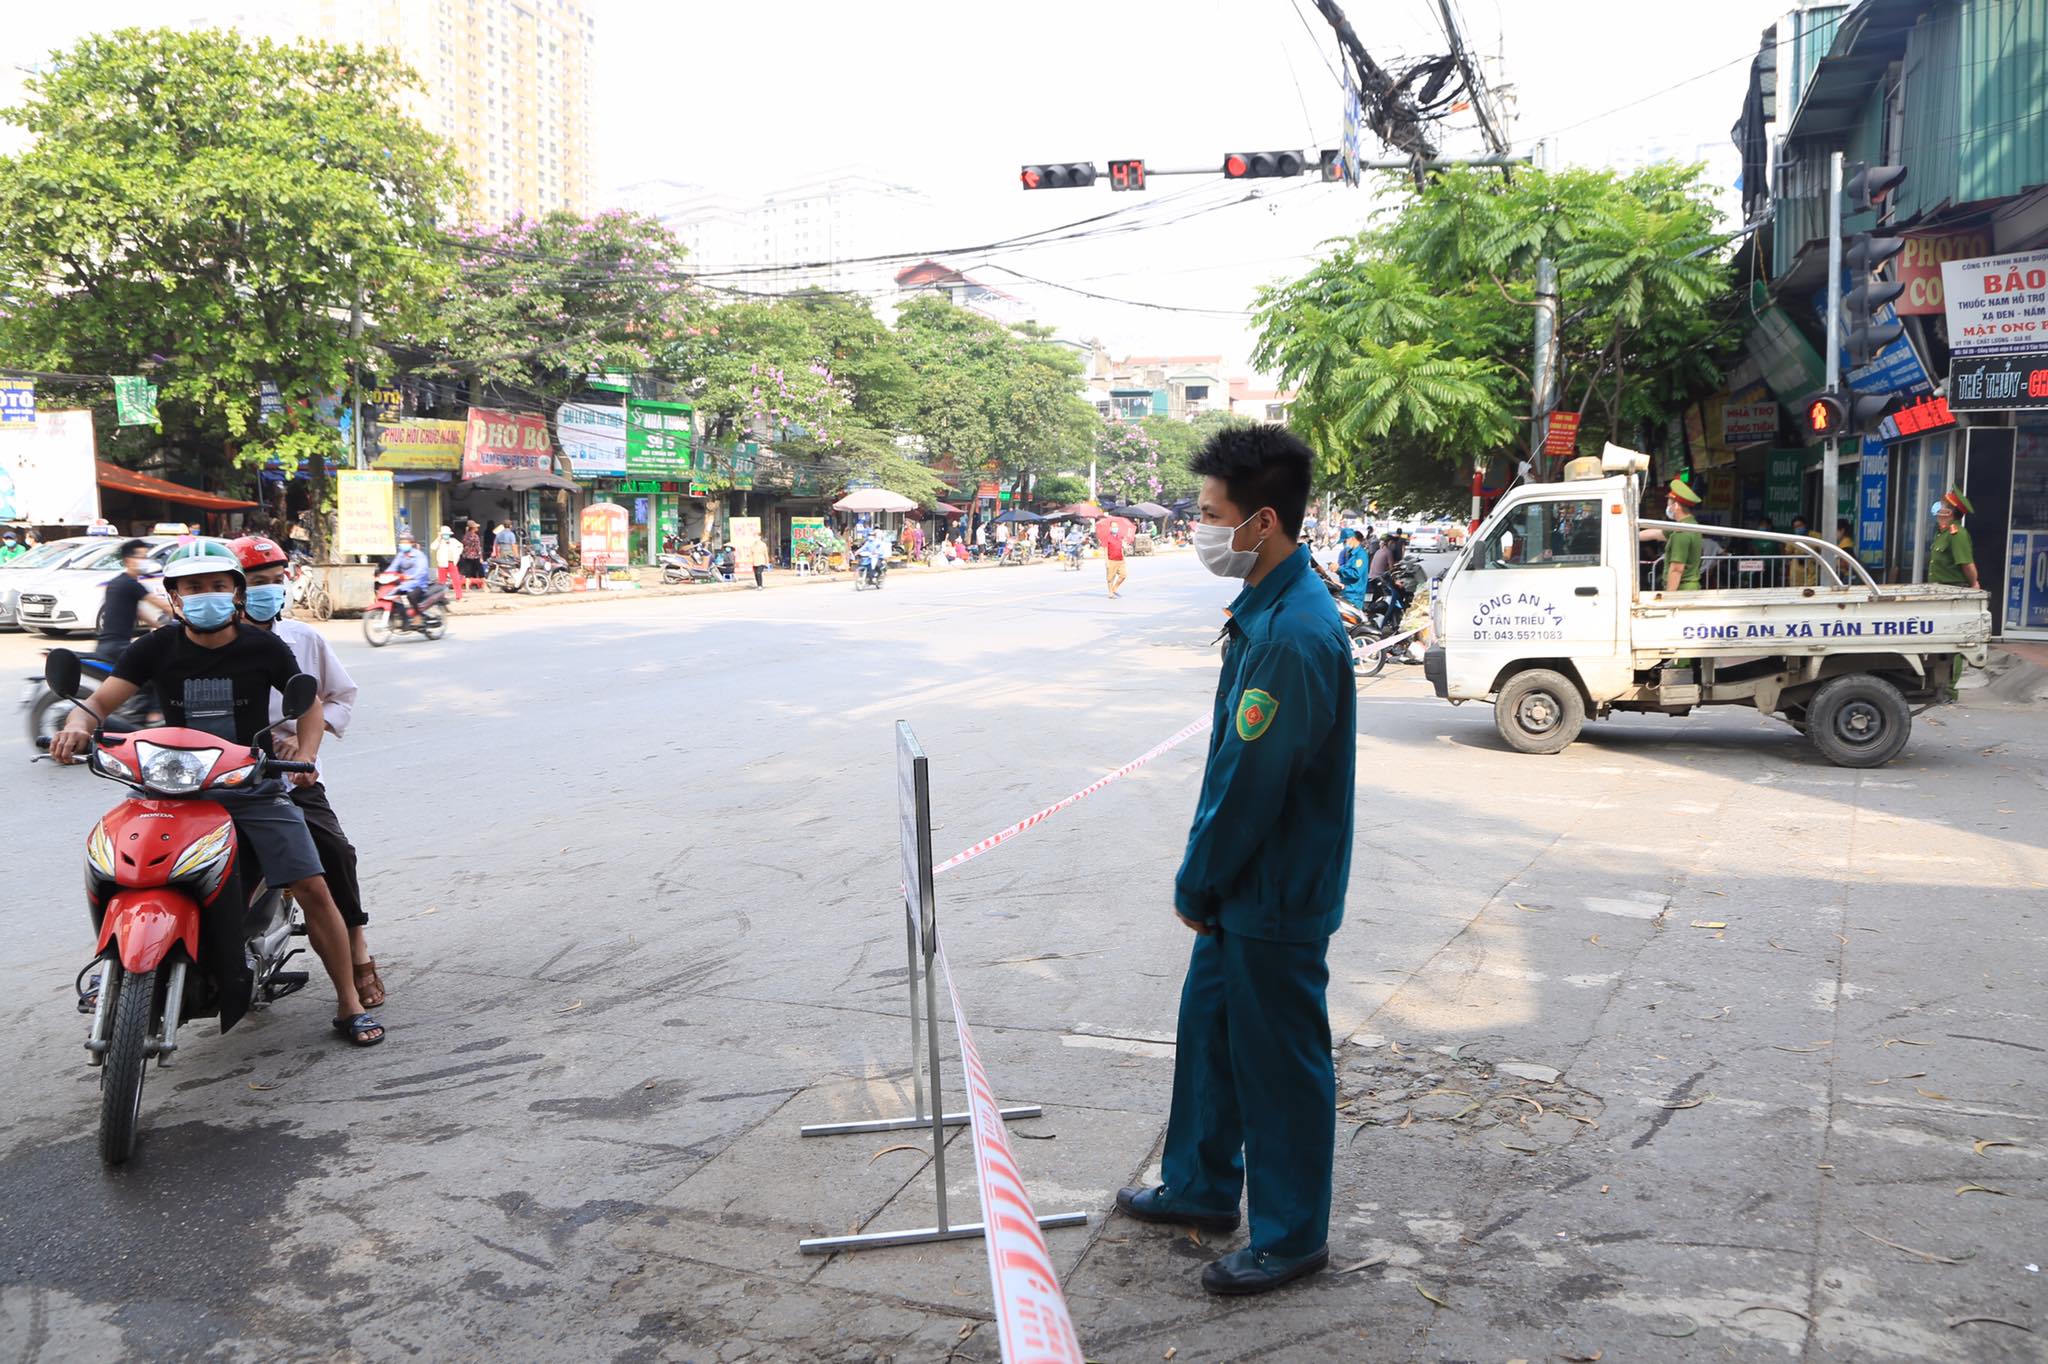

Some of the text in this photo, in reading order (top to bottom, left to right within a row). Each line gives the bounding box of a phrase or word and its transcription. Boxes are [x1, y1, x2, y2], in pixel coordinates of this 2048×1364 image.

[1112, 161, 1143, 187] 47
[1983, 265, 2047, 295] BẢO
[1958, 298, 1986, 310] THUỐC
[1988, 297, 2010, 307] NAM
[1963, 323, 1997, 337] MẬT
[2001, 321, 2036, 333] ONG
[1958, 364, 1986, 400] THẾ
[1518, 593, 1540, 607] AN
[1683, 622, 1739, 639] CÔNG
[1746, 623, 1775, 638] AN
[1786, 620, 1814, 638] XÃ
[1820, 619, 1862, 637] TÂN
